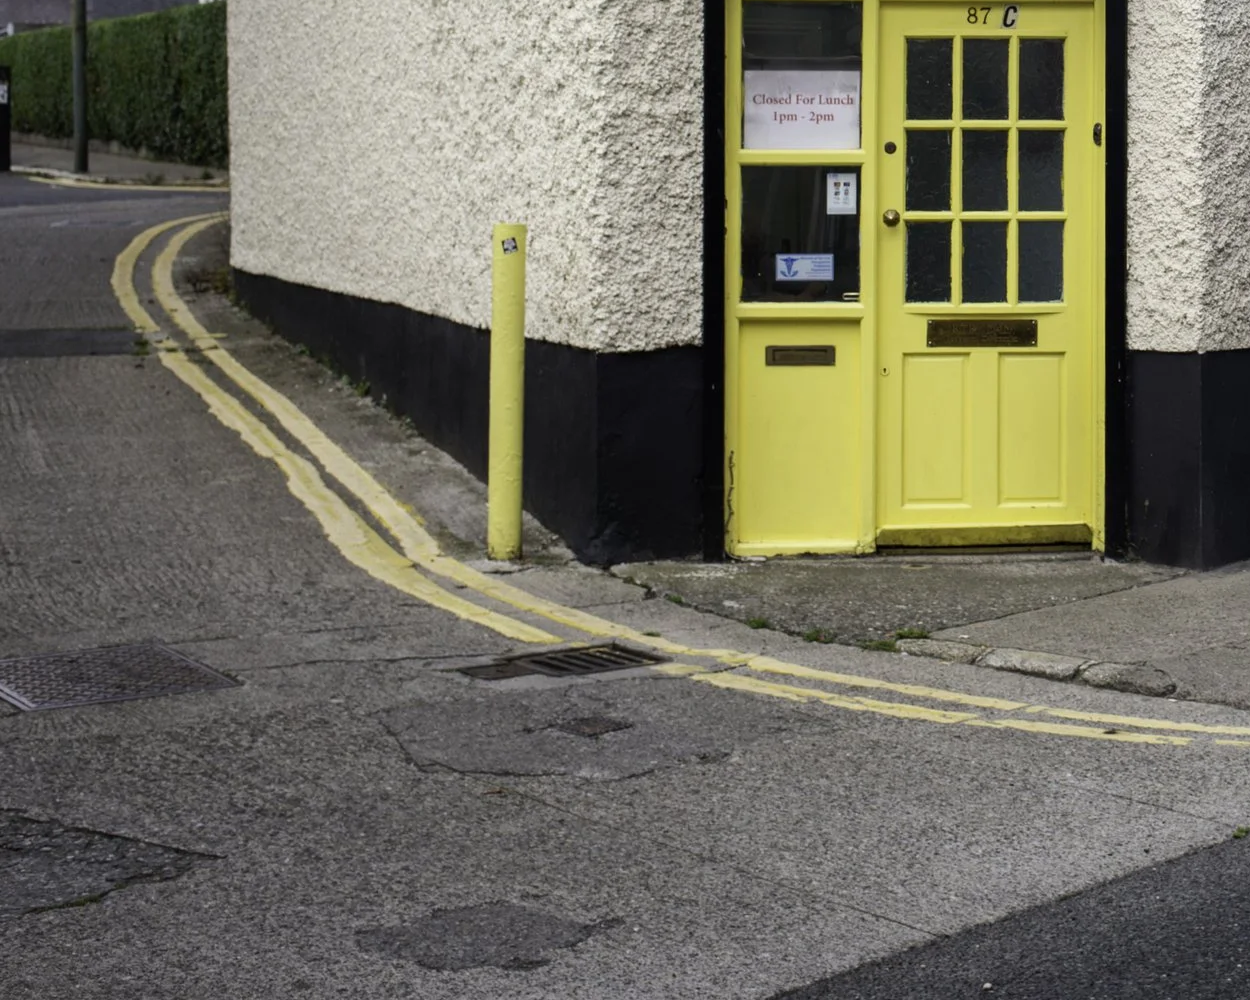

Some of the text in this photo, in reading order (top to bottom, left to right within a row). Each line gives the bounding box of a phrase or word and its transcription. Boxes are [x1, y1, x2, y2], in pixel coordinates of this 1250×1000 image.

[966, 5, 1019, 28] 87 C
[752, 93, 855, 106] Closed For Lunch
[772, 110, 797, 125] 1pm
[809, 111, 835, 125] 2pm
